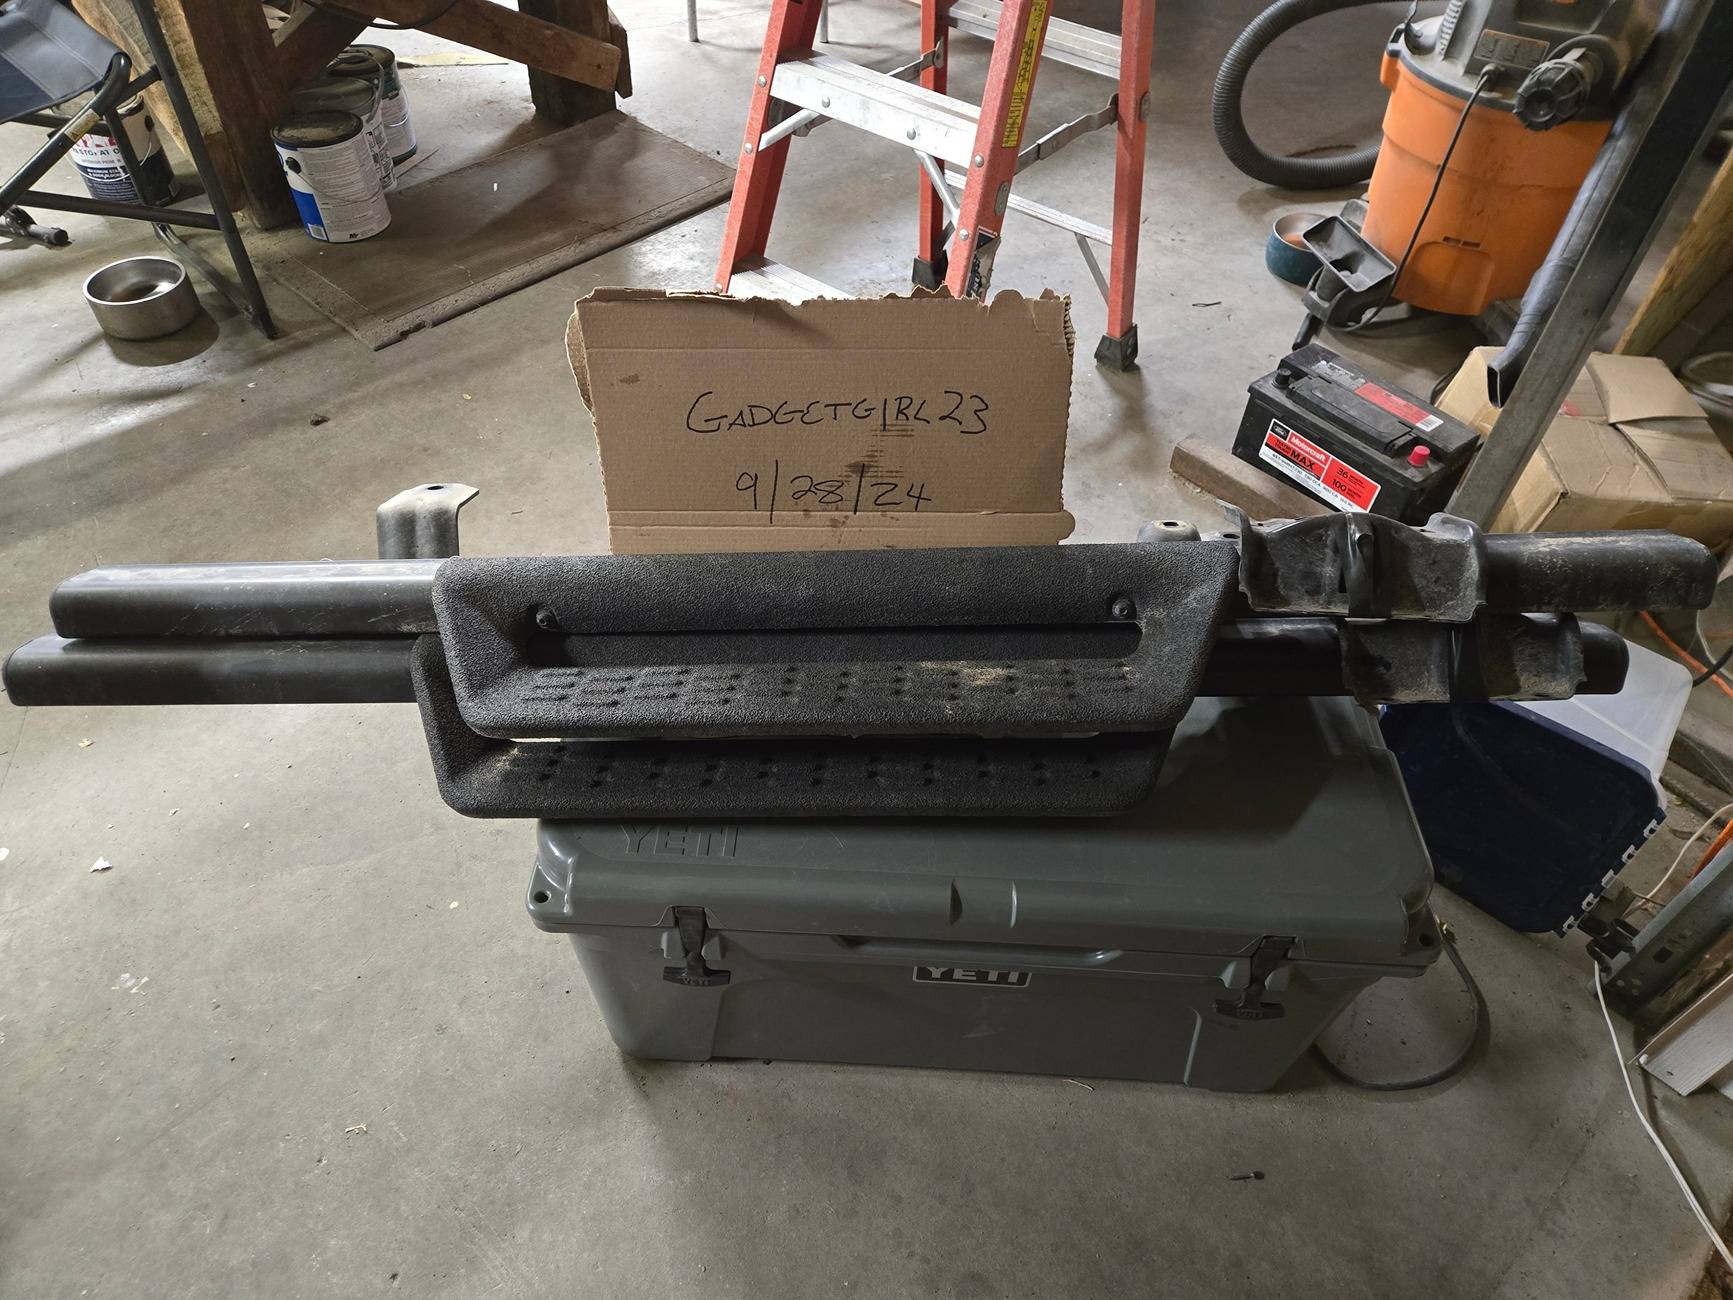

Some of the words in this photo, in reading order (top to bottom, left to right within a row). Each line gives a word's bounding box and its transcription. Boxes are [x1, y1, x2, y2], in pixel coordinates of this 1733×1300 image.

[1290, 435, 1326, 463] Motorcraft
[1291, 449, 1315, 470] MAX
[1336, 467, 1349, 478] 36
[736, 459, 931, 524] 9/28/24
[1332, 479, 1347, 491] 100
[619, 825, 741, 857] YETI
[927, 966, 1019, 983] YETI
